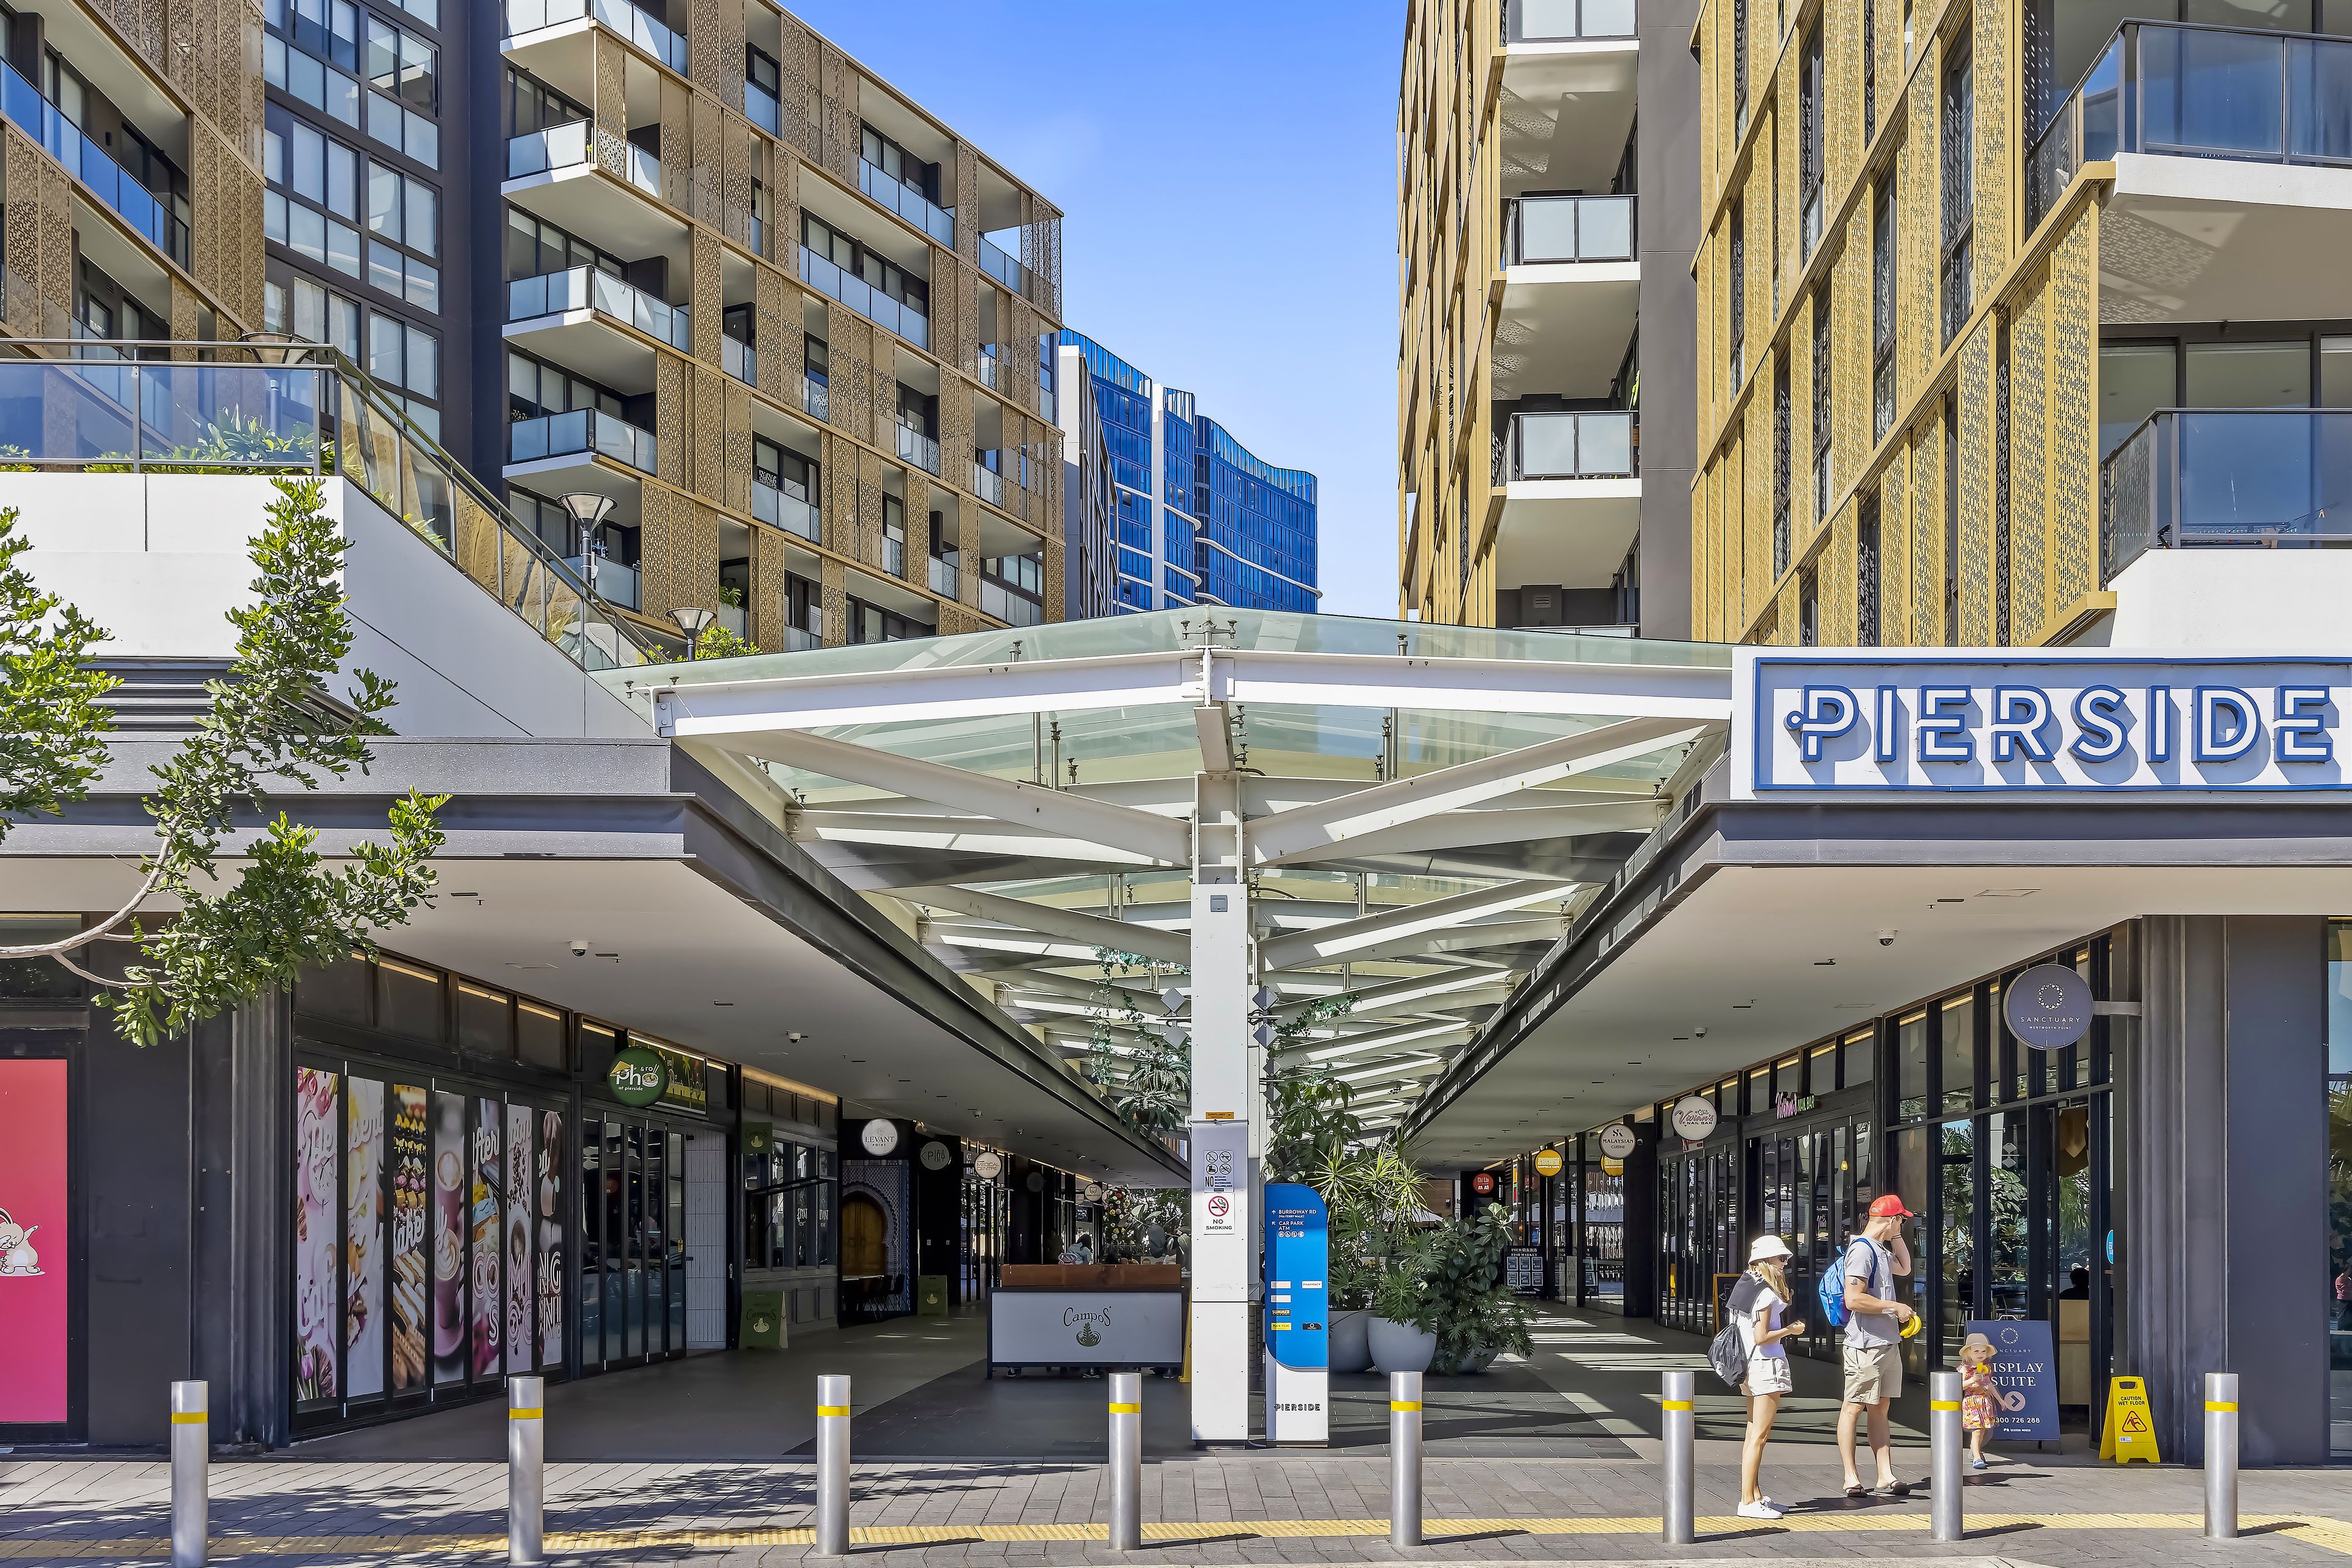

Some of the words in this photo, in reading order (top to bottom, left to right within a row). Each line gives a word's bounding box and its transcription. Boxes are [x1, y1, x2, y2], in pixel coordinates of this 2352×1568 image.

[1783, 685, 2332, 763] PIERSIDE
[1806, 1095, 1815, 1110] BAR
[928, 1152, 933, 1161] P
[1205, 1176, 1214, 1187] NO
[473, 1251, 561, 1299] COMING
[1992, 1362, 2044, 1373] ISPLAY
[1991, 1376, 2036, 1386] SUITE
